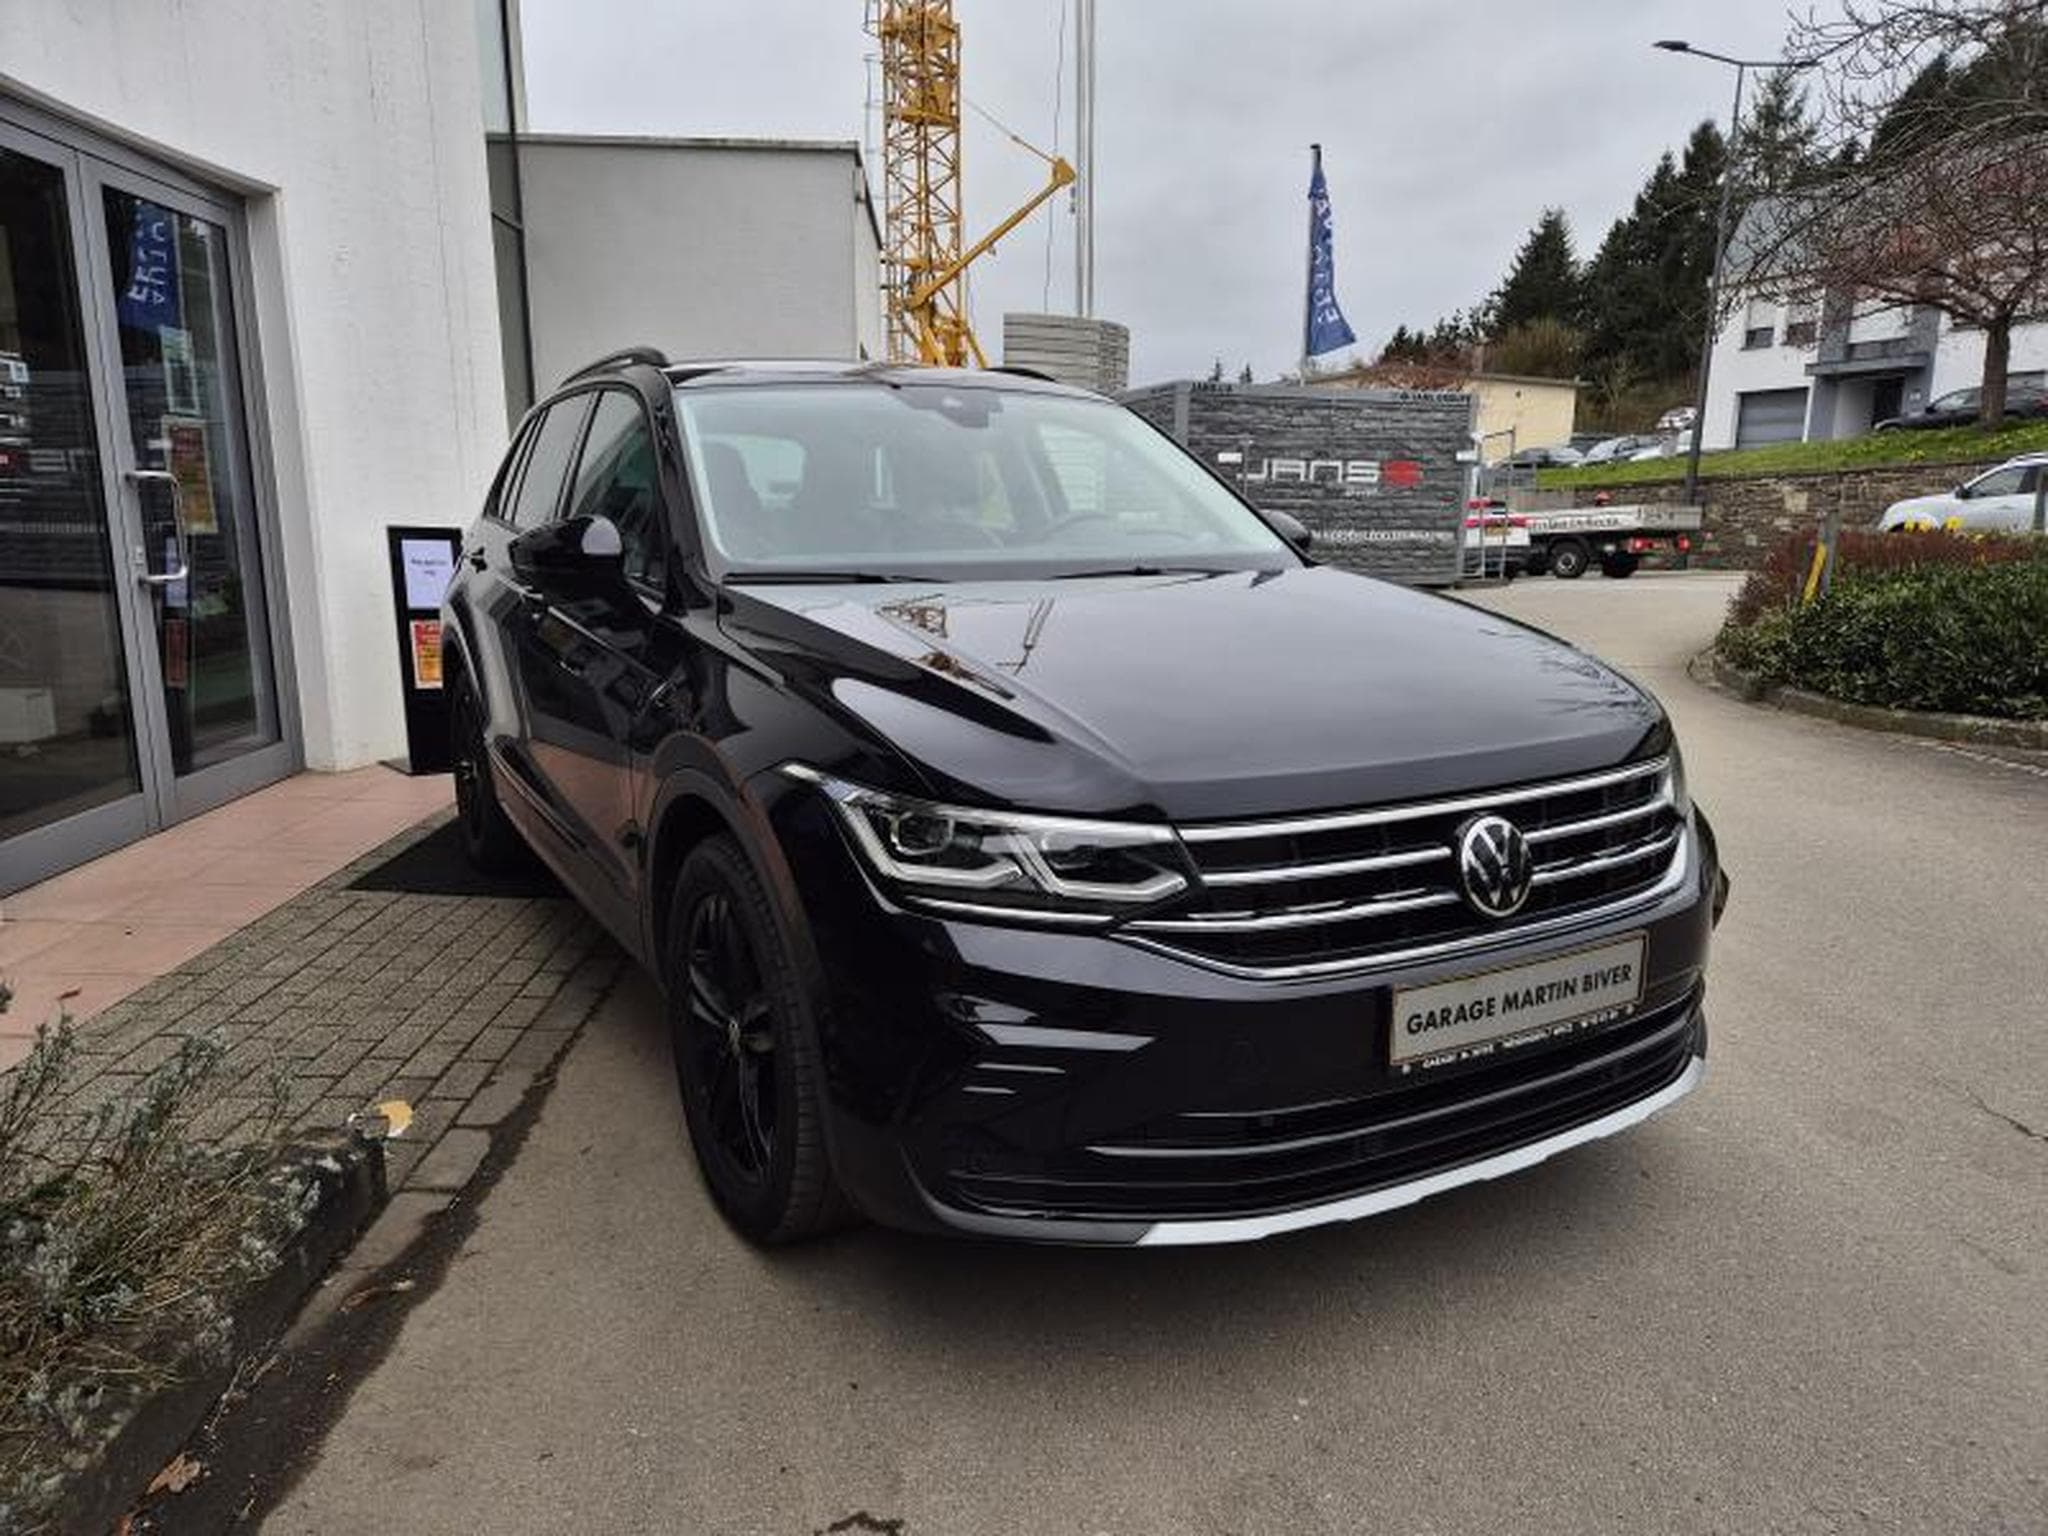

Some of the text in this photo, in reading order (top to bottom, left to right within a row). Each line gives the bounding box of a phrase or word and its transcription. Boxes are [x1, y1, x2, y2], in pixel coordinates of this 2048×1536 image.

[1237, 457, 1380, 484] JANS
[1406, 964, 1632, 1035] GARAGE MARTIN BIVER
